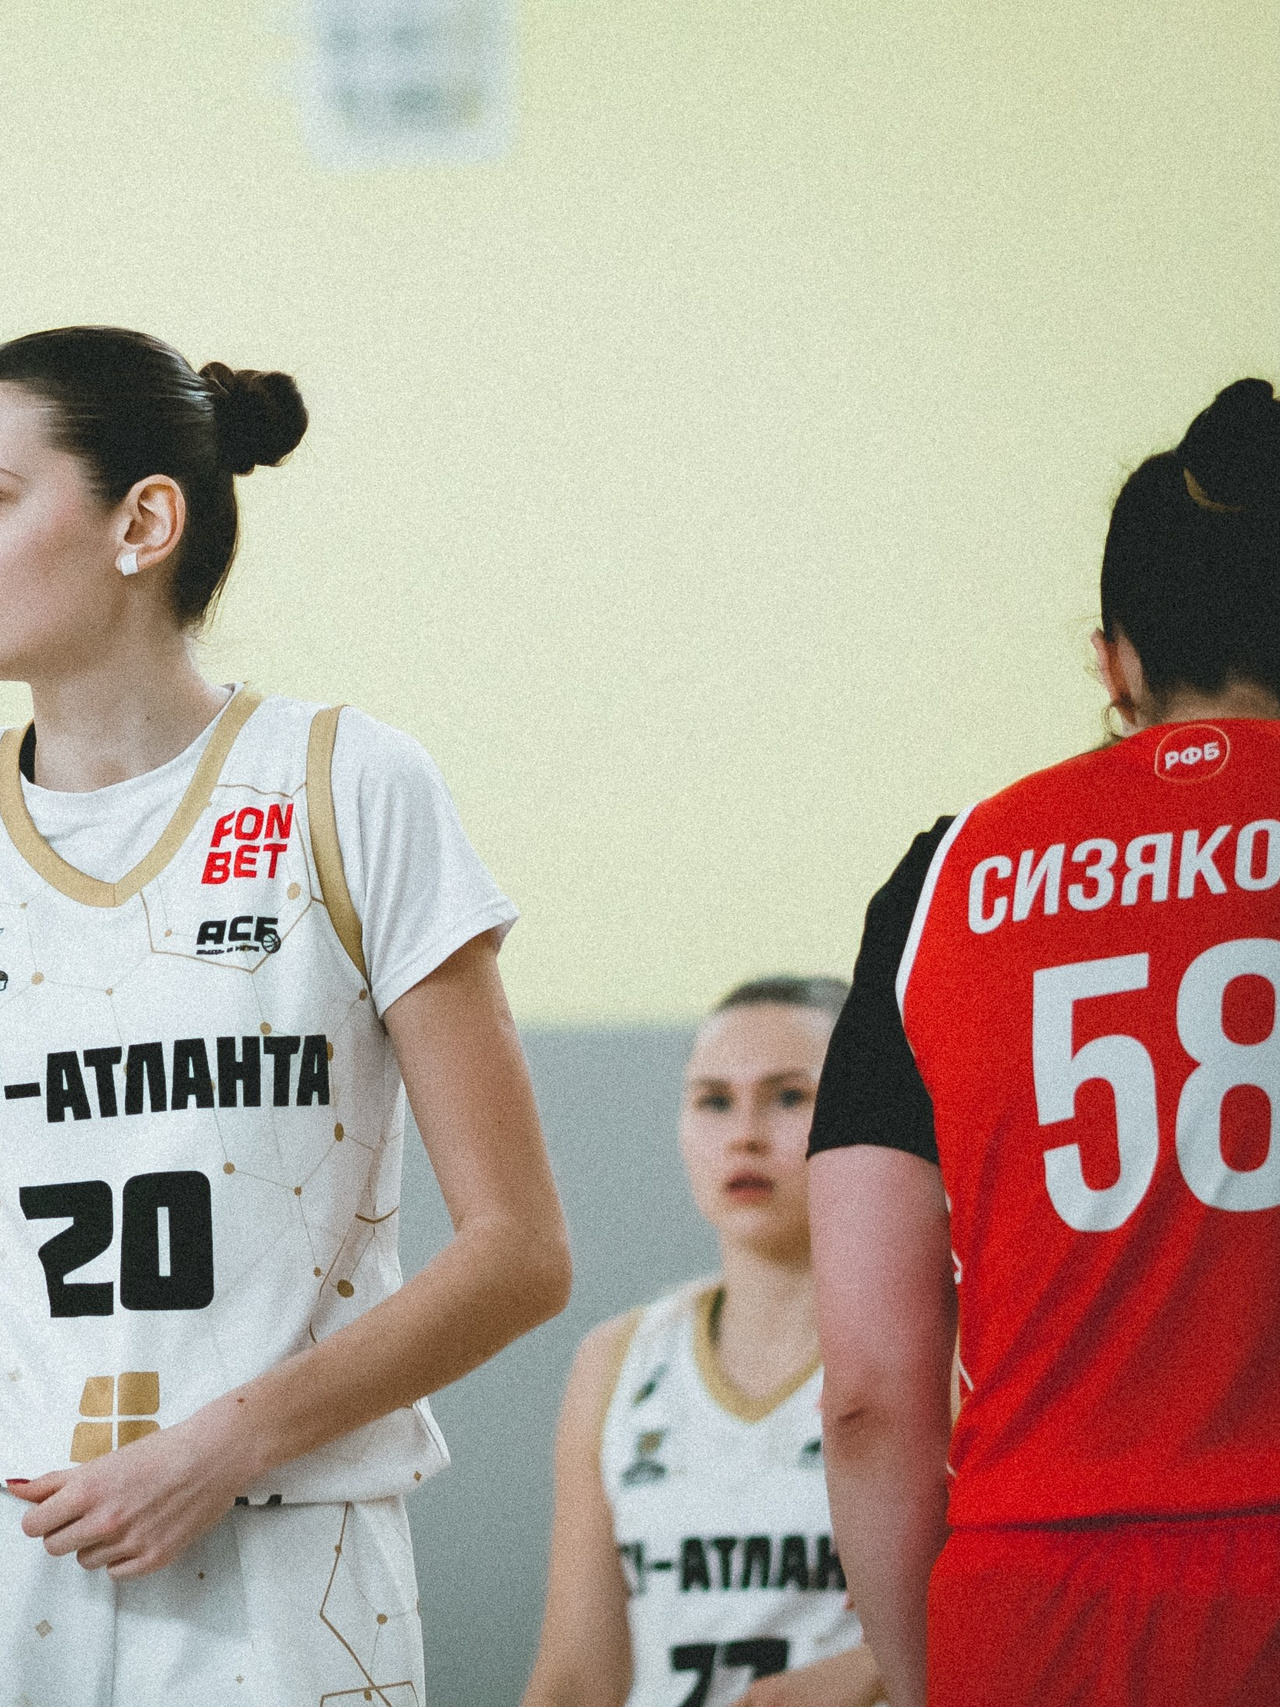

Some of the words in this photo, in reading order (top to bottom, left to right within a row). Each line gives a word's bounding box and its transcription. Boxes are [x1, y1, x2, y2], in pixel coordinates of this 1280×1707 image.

[1164, 741, 1220, 771] РФБ
[201, 843, 287, 884] BET
[210, 803, 294, 847] FON
[967, 818, 1280, 935] СИЗЯКО
[1033, 937, 1280, 1232] 58
[19, 1170, 215, 1318] 20
